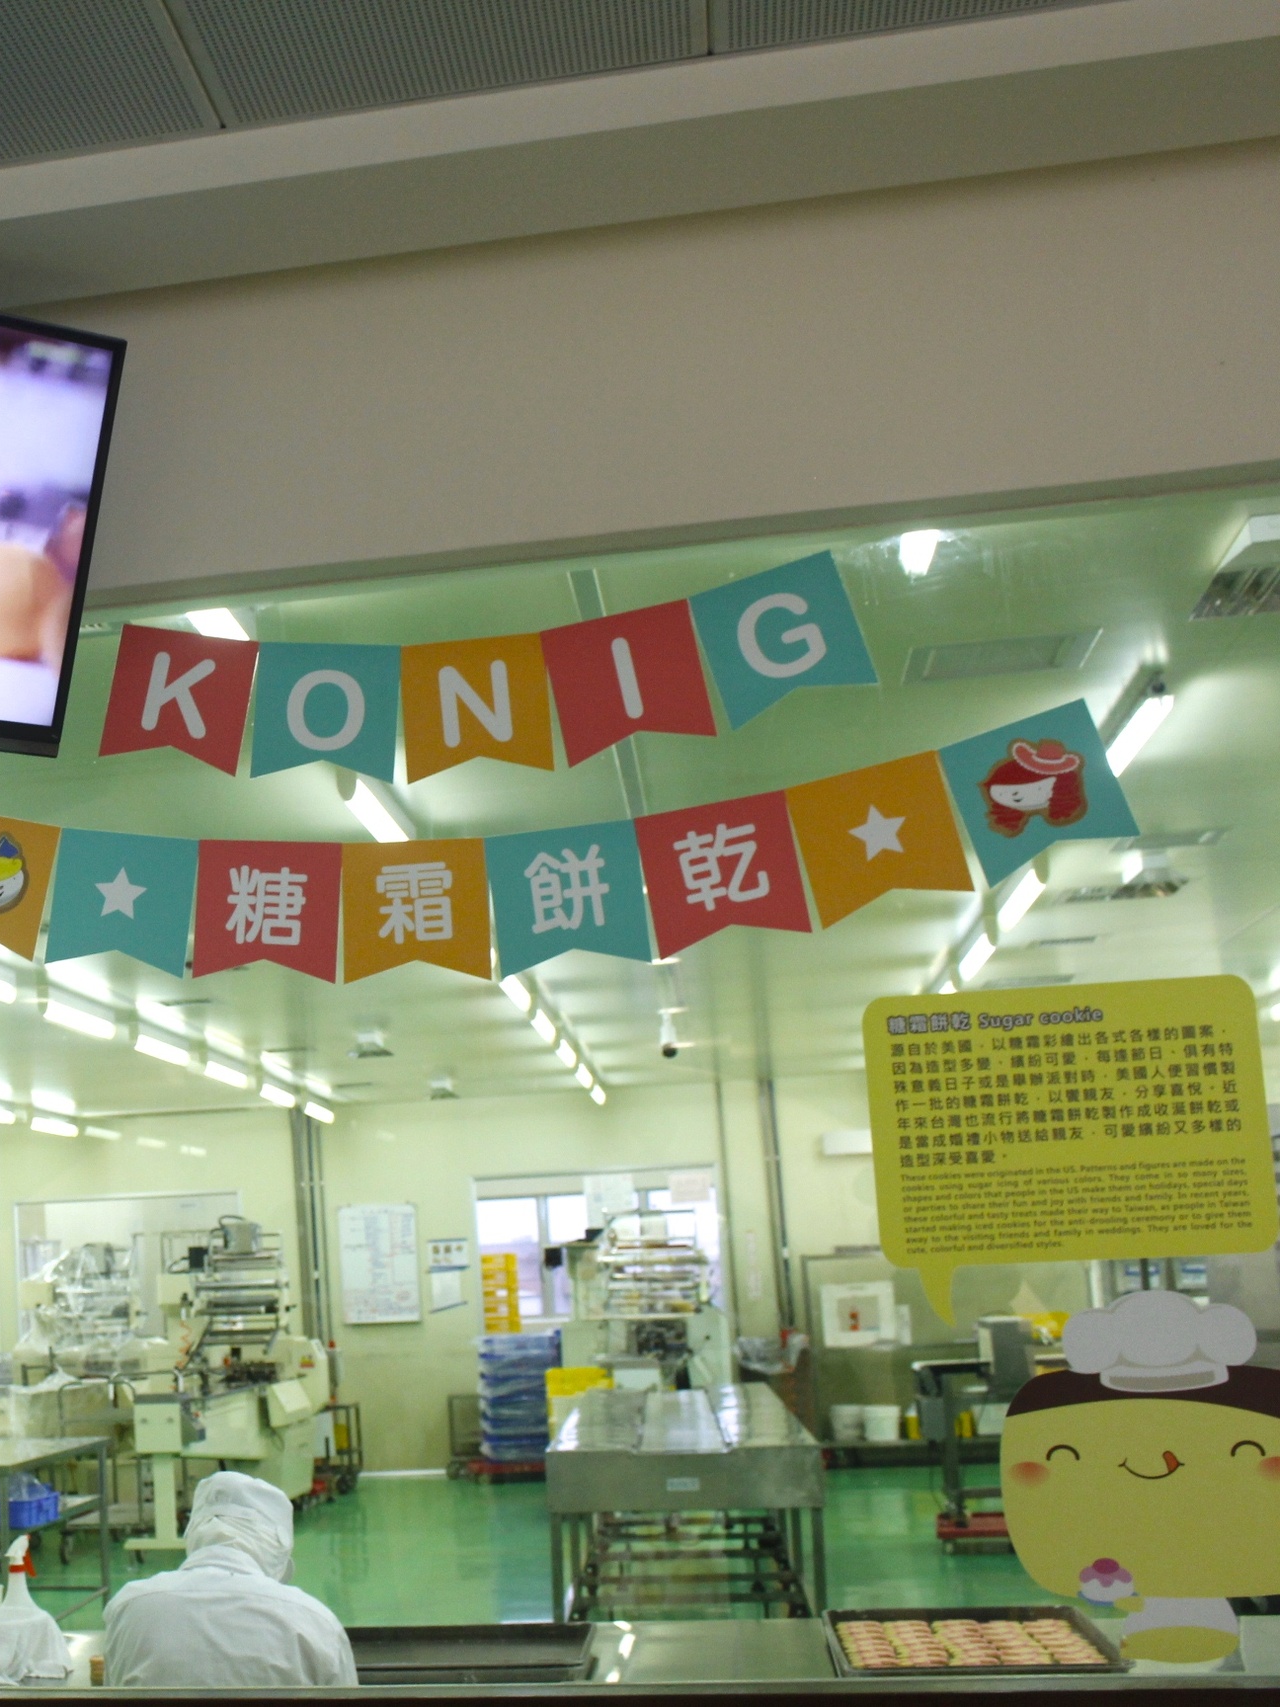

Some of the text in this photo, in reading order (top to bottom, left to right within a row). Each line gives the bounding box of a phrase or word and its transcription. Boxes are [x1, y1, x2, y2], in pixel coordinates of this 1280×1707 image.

[142, 594, 826, 751] KONIG
[226, 824, 769, 945] 糖霜餅乾
[886, 1004, 1103, 1035] 糖霜餅乾 Sugar cookie
